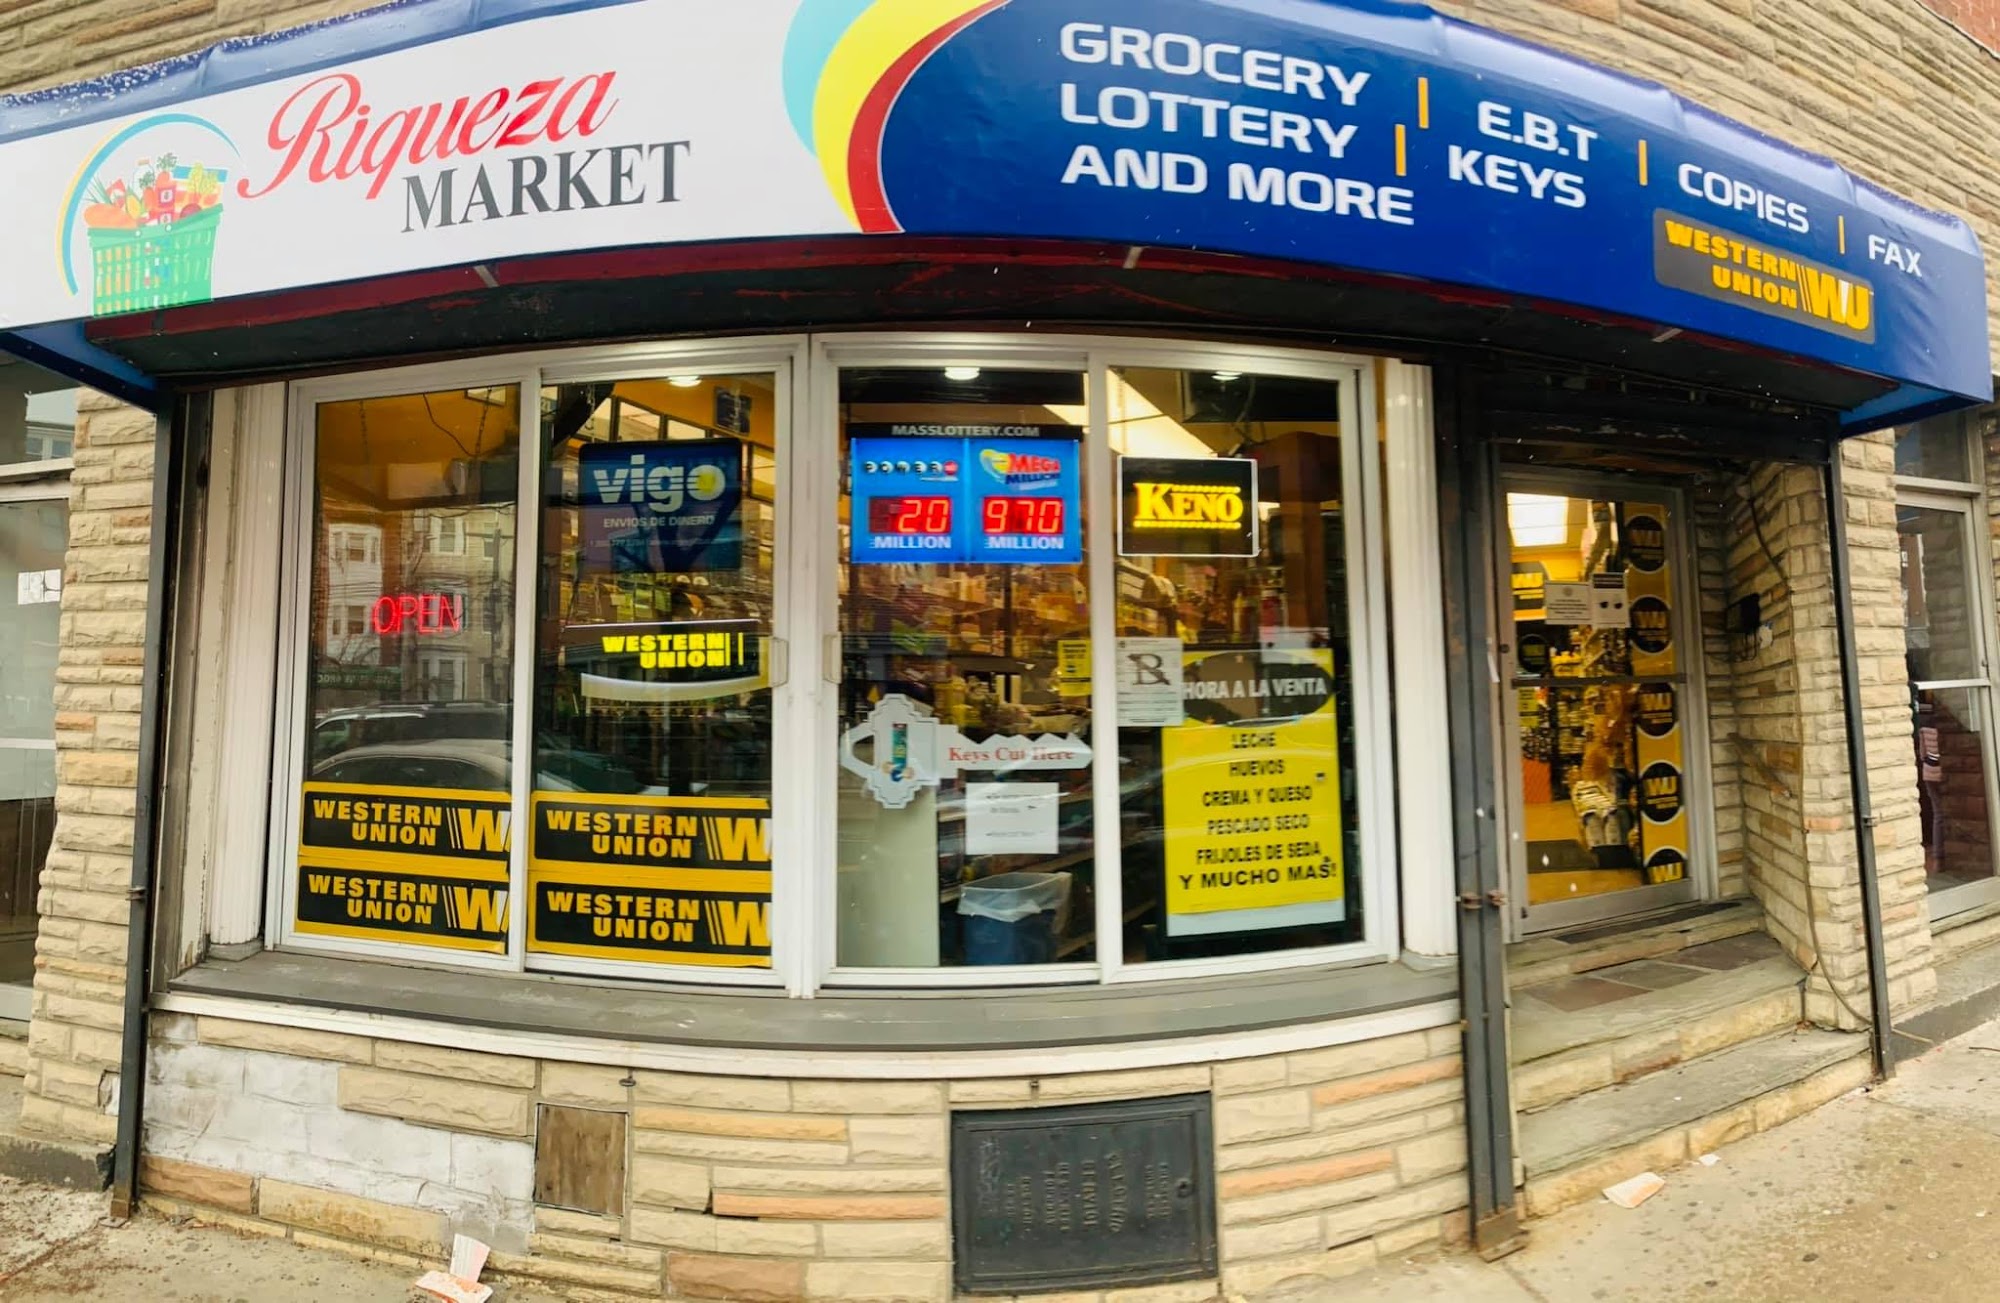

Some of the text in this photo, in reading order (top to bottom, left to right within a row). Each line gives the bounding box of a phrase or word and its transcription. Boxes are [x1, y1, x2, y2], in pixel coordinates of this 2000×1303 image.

[1060, 22, 1371, 106] GROCERY
[1061, 83, 1358, 159] LOTTERY
[1478, 101, 1598, 161] E.B.T
[238, 71, 619, 200] Riqueza
[400, 140, 690, 232] MARKET
[1061, 145, 1415, 225] AND MORE
[1448, 144, 1587, 208] KEYS
[1678, 163, 1810, 233] COPIES
[1665, 220, 1798, 279] WESTERN
[1868, 234, 1923, 278] FAX
[1711, 264, 1798, 309] UNION
[1804, 267, 1874, 331] WU
[891, 425, 1040, 437] MASSLOTTERY.COM
[1007, 453, 1061, 474] MEGA
[593, 454, 726, 513] vigo
[603, 514, 715, 529] ENVIOS DE DINERO
[898, 500, 949, 533] 20
[985, 500, 1062, 533] 970
[874, 536, 951, 549] MILLION
[988, 536, 1064, 549] MILLION
[373, 593, 463, 634] OPEN
[602, 632, 726, 653] WESTERN
[640, 650, 725, 669] UNION
[1183, 678, 1327, 700] HORA A LA VENTA
[1232, 732, 1277, 749] LECHE
[948, 747, 989, 765] Keys
[995, 746, 1026, 761] Cut
[1229, 760, 1285, 777] HUEVOS
[1202, 786, 1313, 807] CREMA Y QUESO
[313, 799, 442, 826] WESTERN
[546, 810, 698, 837] WESTERN
[1207, 814, 1310, 835] PESCADO SECO
[352, 823, 437, 846] UNION
[592, 835, 692, 859] UNION
[1196, 841, 1321, 865] FRIJOLES DE SEDA
[308, 874, 438, 904] WESTERN
[1179, 875, 1193, 890] Y
[1201, 869, 1280, 889] MUCHO
[347, 899, 433, 925] UNION
[547, 891, 701, 921] WESTERN
[593, 917, 694, 943] UNION
